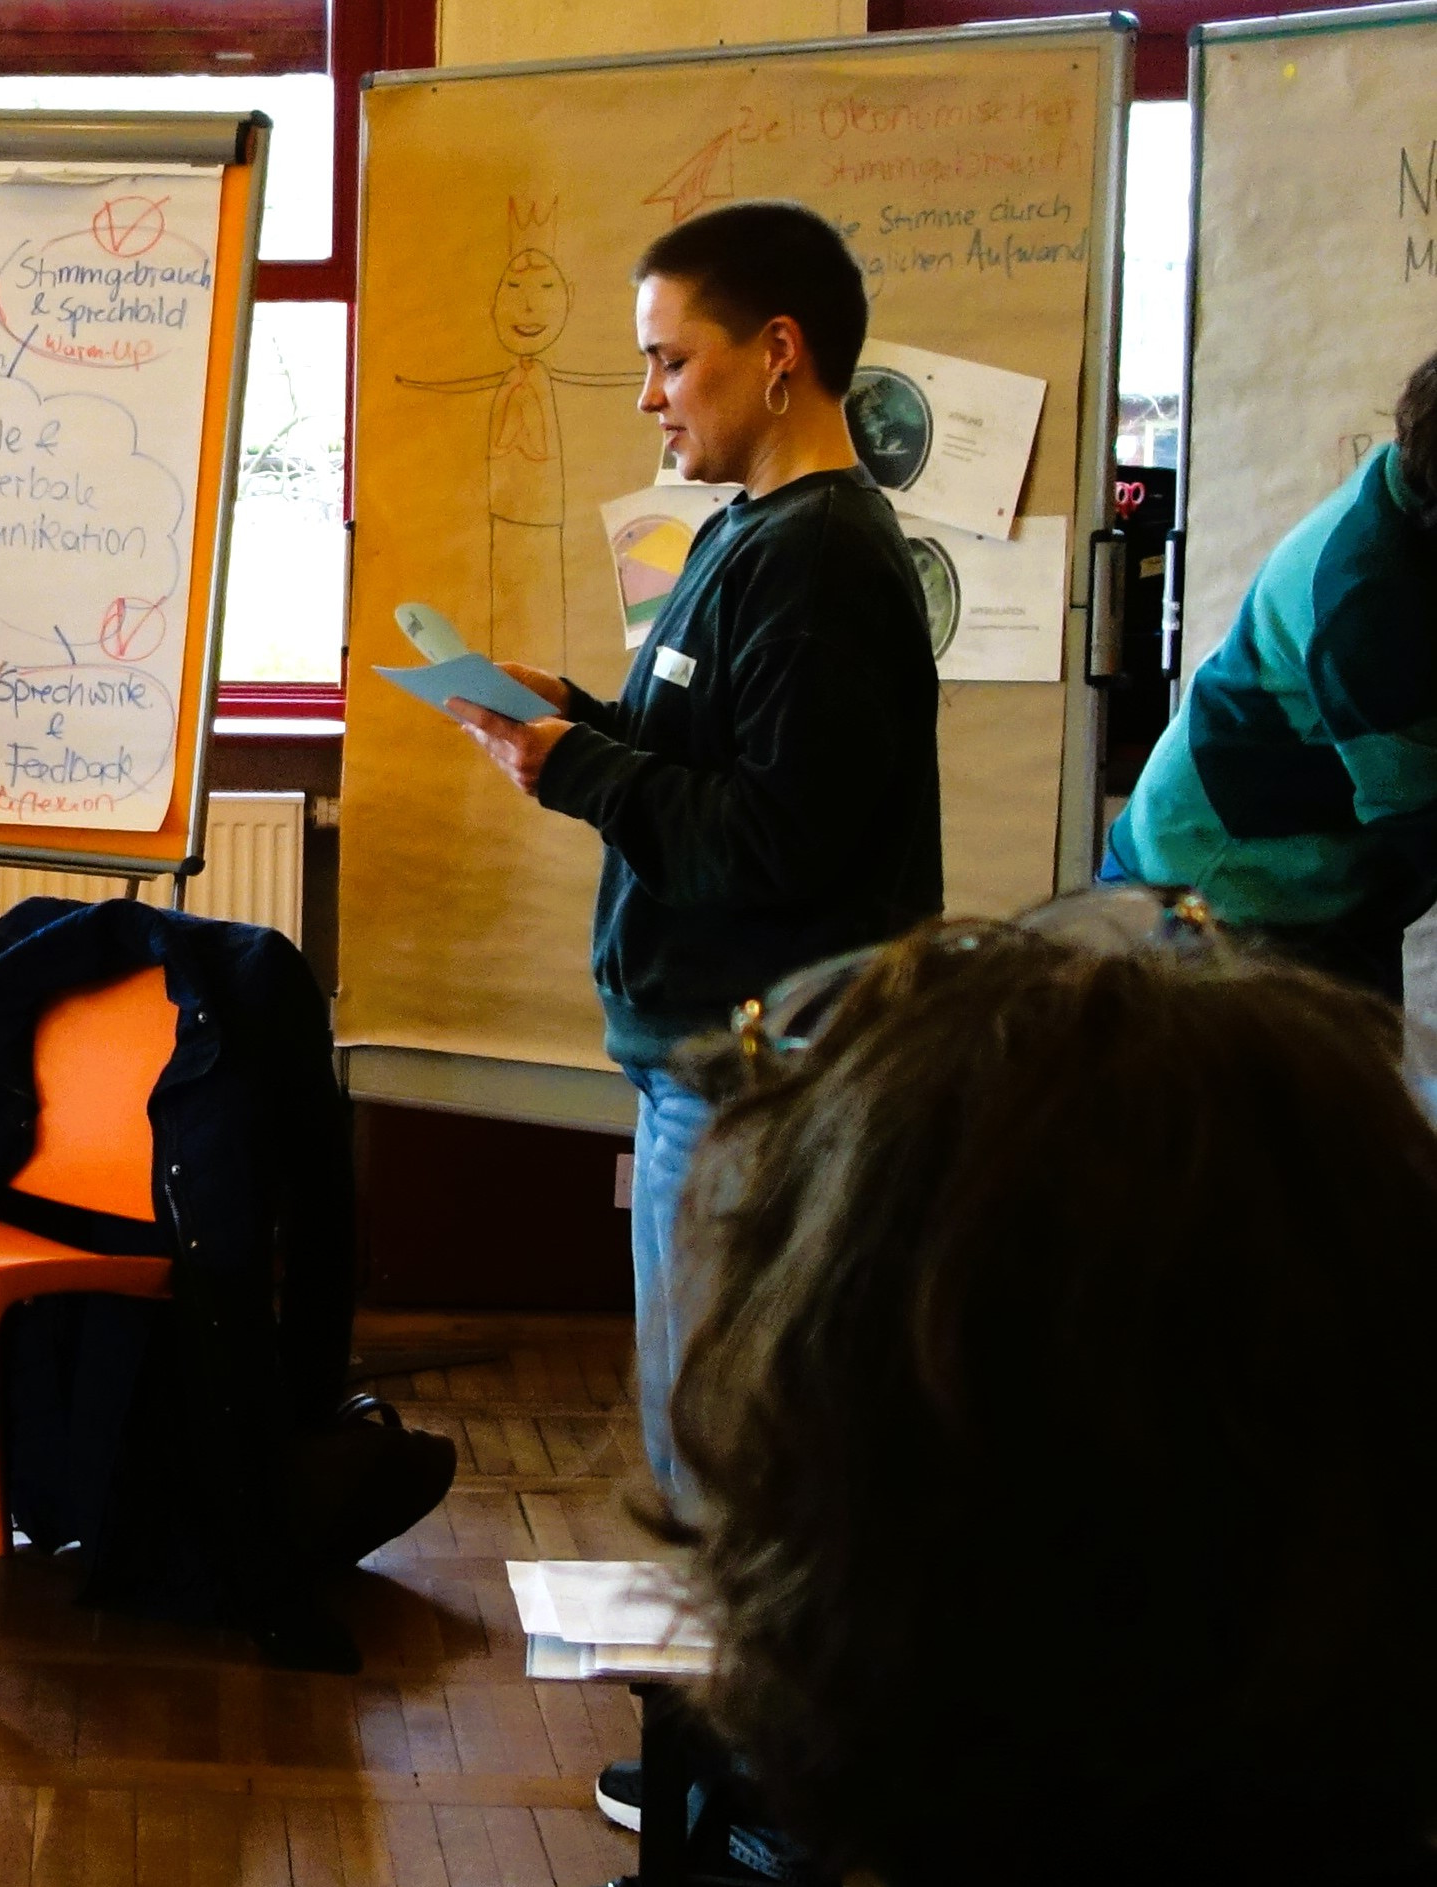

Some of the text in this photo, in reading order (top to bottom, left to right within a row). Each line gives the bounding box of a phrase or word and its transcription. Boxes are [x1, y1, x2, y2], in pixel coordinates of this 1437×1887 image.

[989, 196, 1072, 224] durch
[966, 229, 1088, 280] Aufwand
[16, 257, 212, 302] Stimmgebrauch
[31, 293, 187, 338] & Sprechbild
[6, 742, 133, 787] Feedback
